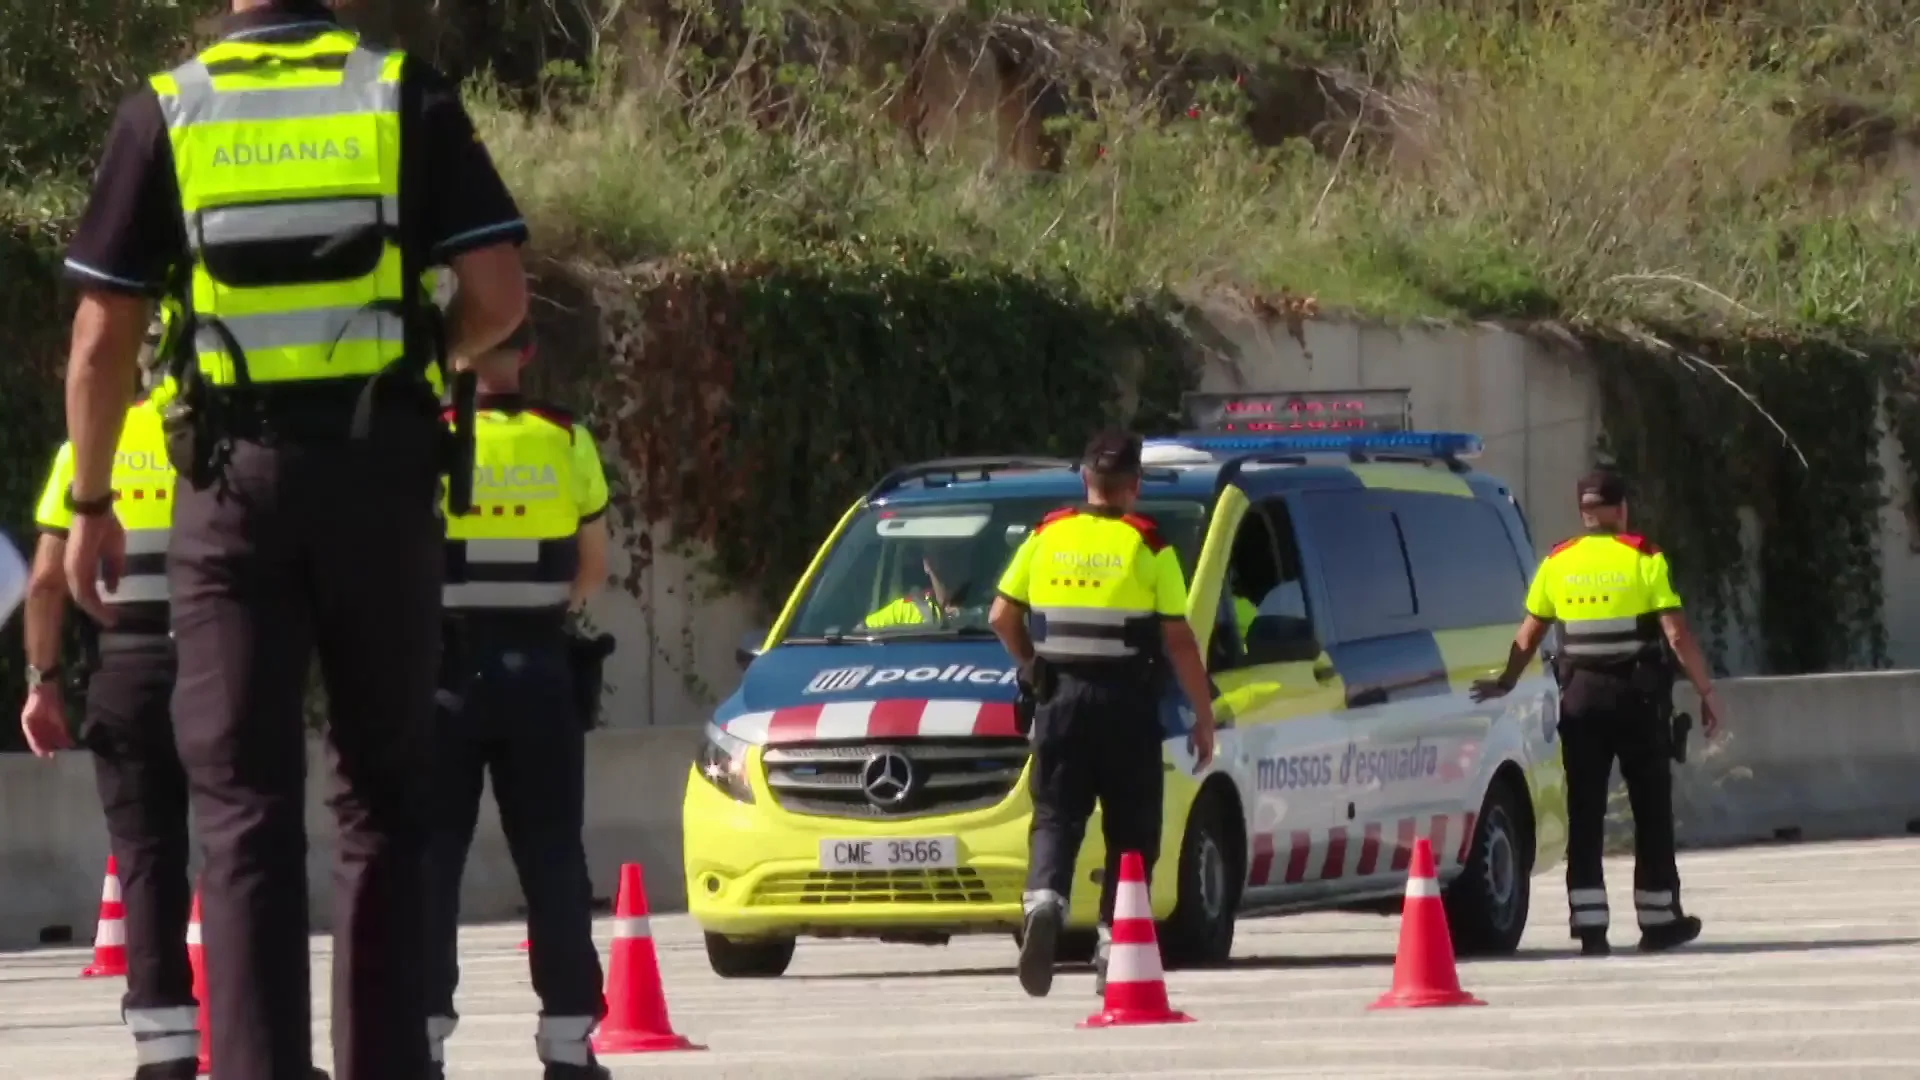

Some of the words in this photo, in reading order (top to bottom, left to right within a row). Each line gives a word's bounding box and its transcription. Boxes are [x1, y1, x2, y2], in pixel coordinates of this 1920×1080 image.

[211, 136, 361, 168] ADUANAS
[866, 664, 1017, 688] polici
[1257, 754, 1332, 791] mossos
[1339, 736, 1438, 790] d'esquadra
[834, 841, 873, 864] CME
[887, 839, 942, 864] 3566
